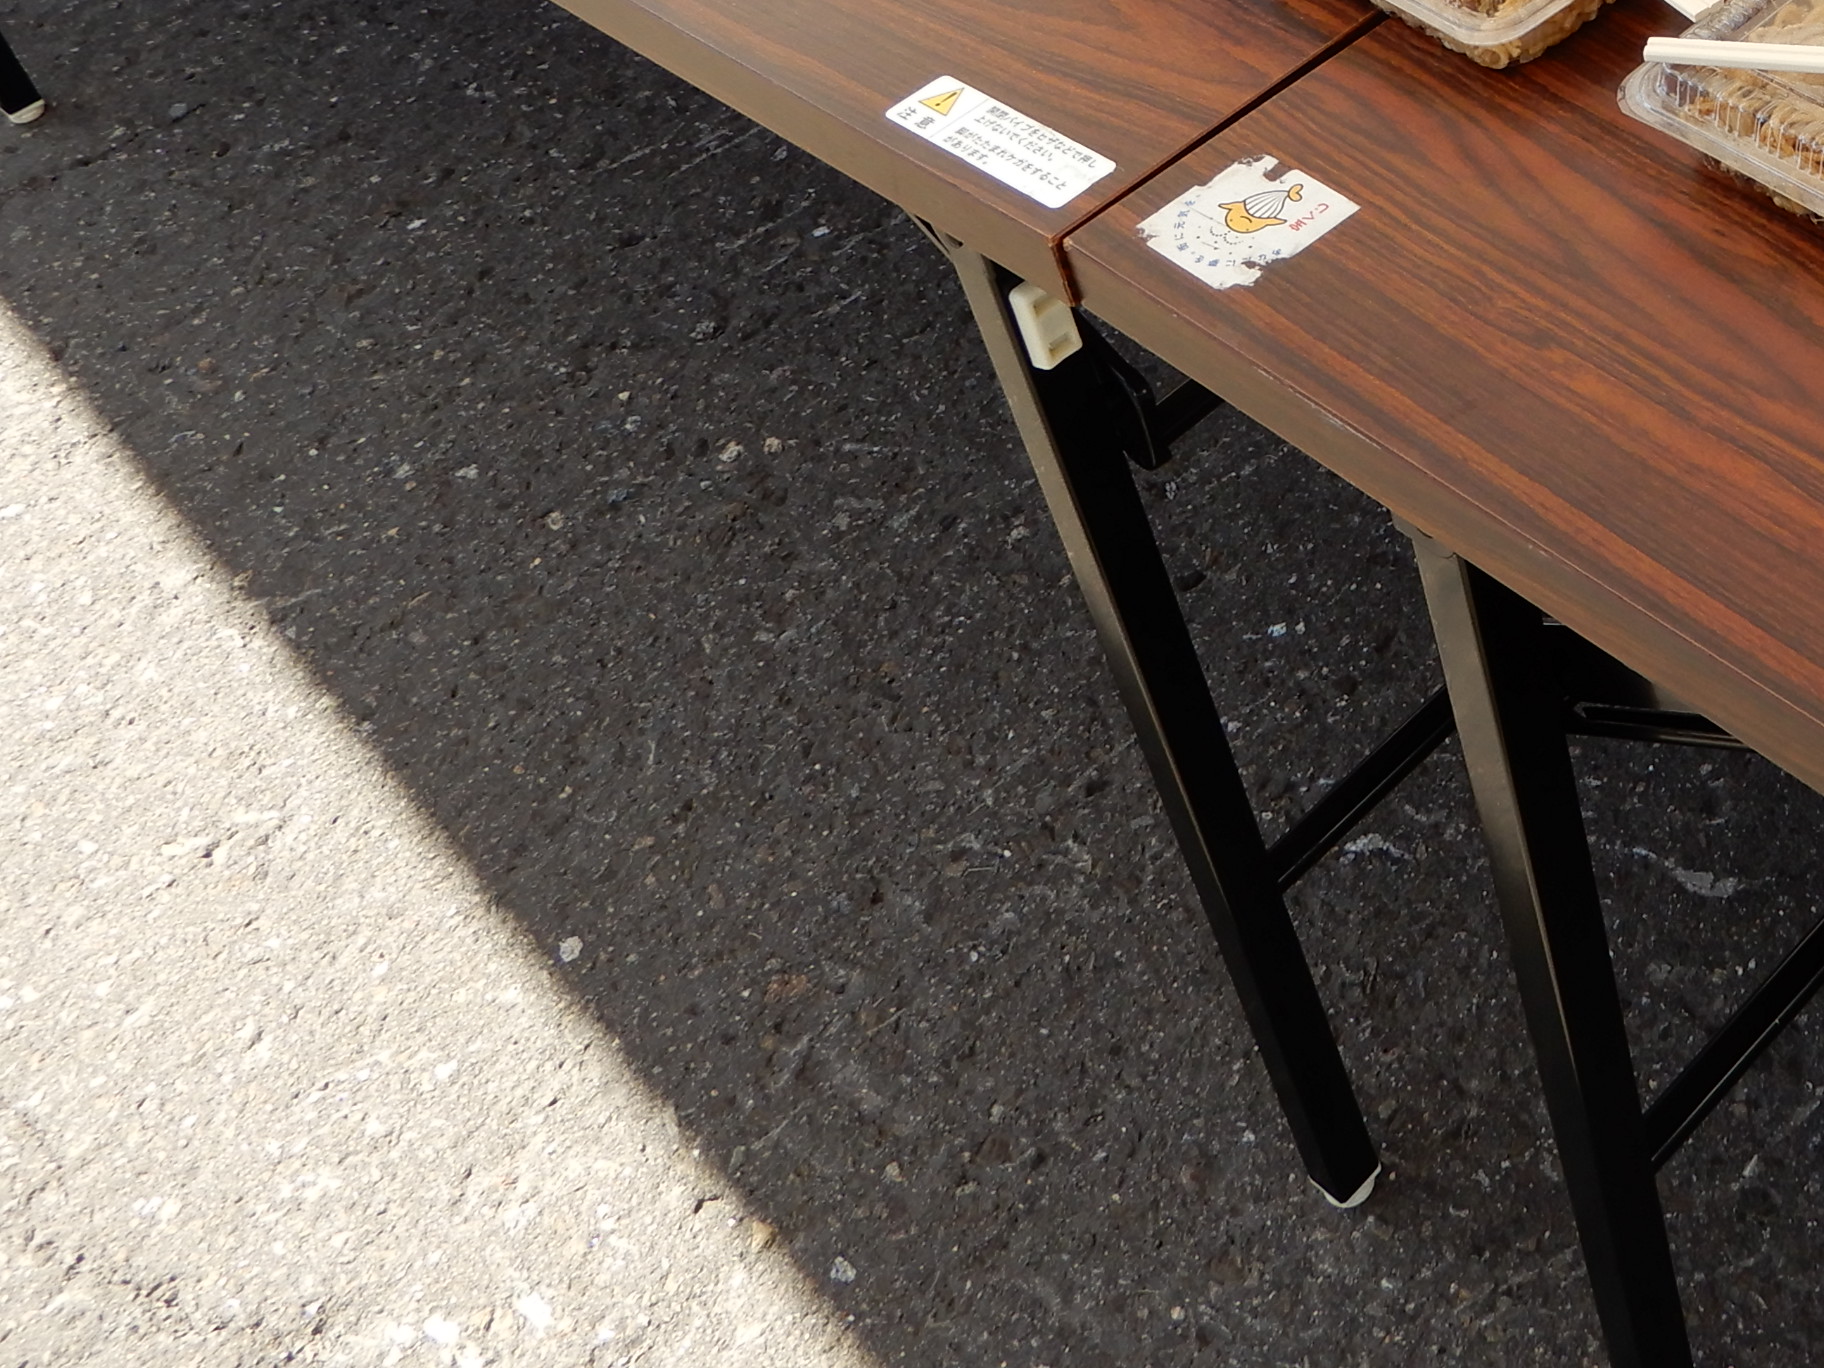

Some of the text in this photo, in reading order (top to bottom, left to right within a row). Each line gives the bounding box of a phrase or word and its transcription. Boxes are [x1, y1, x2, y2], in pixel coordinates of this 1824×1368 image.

[942, 134, 990, 166] があります。
